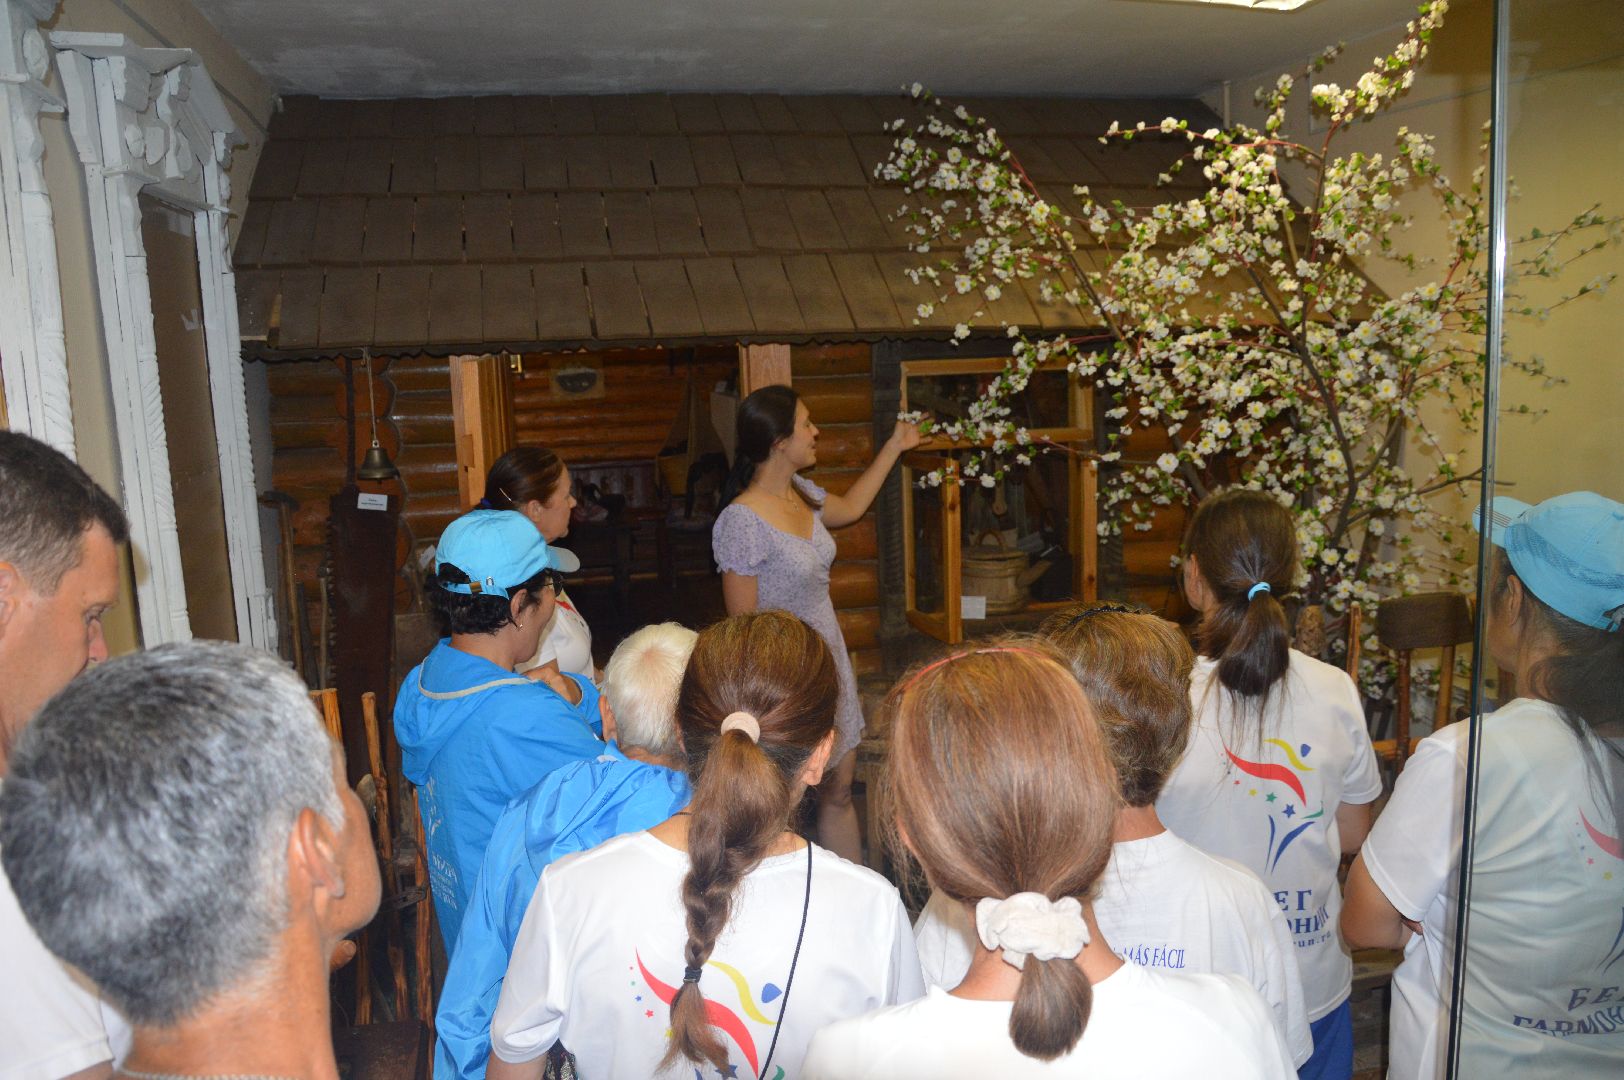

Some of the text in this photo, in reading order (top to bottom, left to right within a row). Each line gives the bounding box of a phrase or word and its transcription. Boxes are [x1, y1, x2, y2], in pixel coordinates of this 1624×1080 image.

[1273, 889, 1312, 911] ЕГ
[1152, 943, 1186, 969] FÁCIL
[1567, 986, 1624, 1012] БЕ
